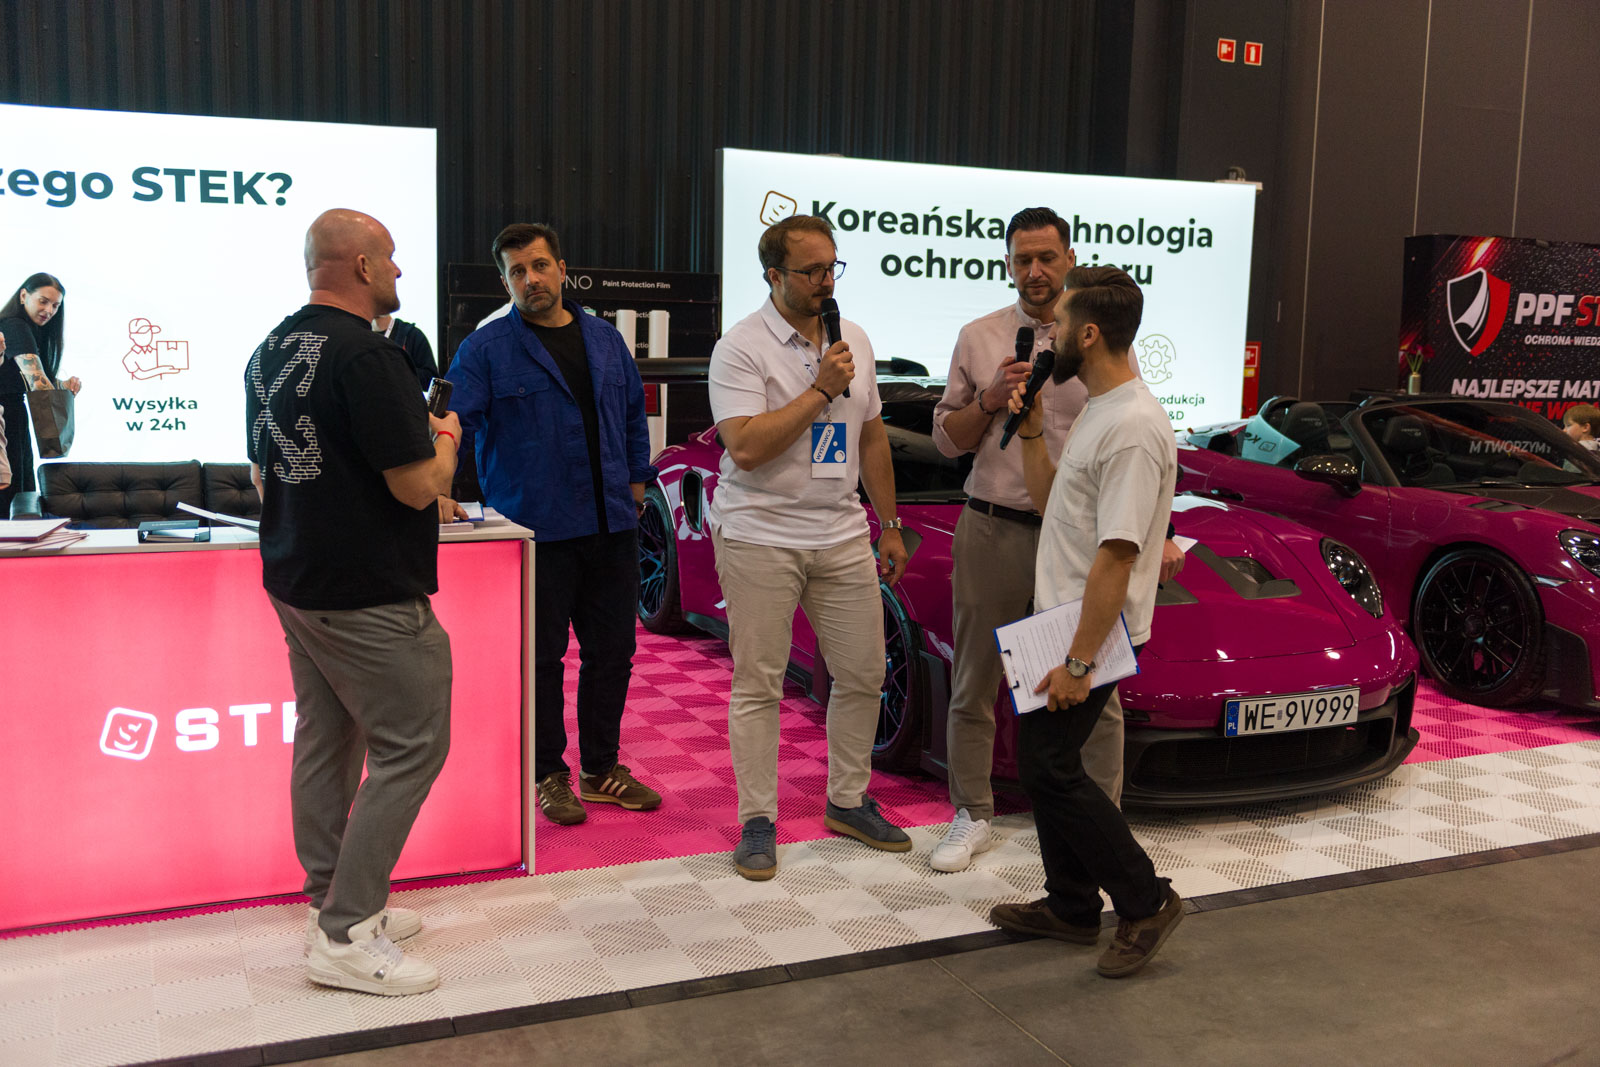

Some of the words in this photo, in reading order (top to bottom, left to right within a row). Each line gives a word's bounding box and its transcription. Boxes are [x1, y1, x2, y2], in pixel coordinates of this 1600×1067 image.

[0, 168, 114, 207] ego
[131, 166, 292, 206] STEK?
[812, 200, 1005, 240] Koreańska
[1073, 215, 1213, 254] hnologia
[881, 249, 1012, 285] ochron
[565, 275, 593, 290] NO
[1514, 293, 1575, 326] PPF
[1524, 335, 1571, 346] OCHRONA
[1451, 379, 1560, 399] NAJLEPSZE
[112, 396, 198, 414] Wysyłka
[1157, 393, 1205, 407] odukcja
[126, 421, 144, 432] w
[150, 417, 186, 431] 24h
[1168, 410, 1185, 421] &D
[815, 428, 833, 460] WYSTAWCA
[1244, 702, 1276, 731] WE
[1285, 694, 1354, 728] 9V999
[1227, 722, 1237, 730] PL
